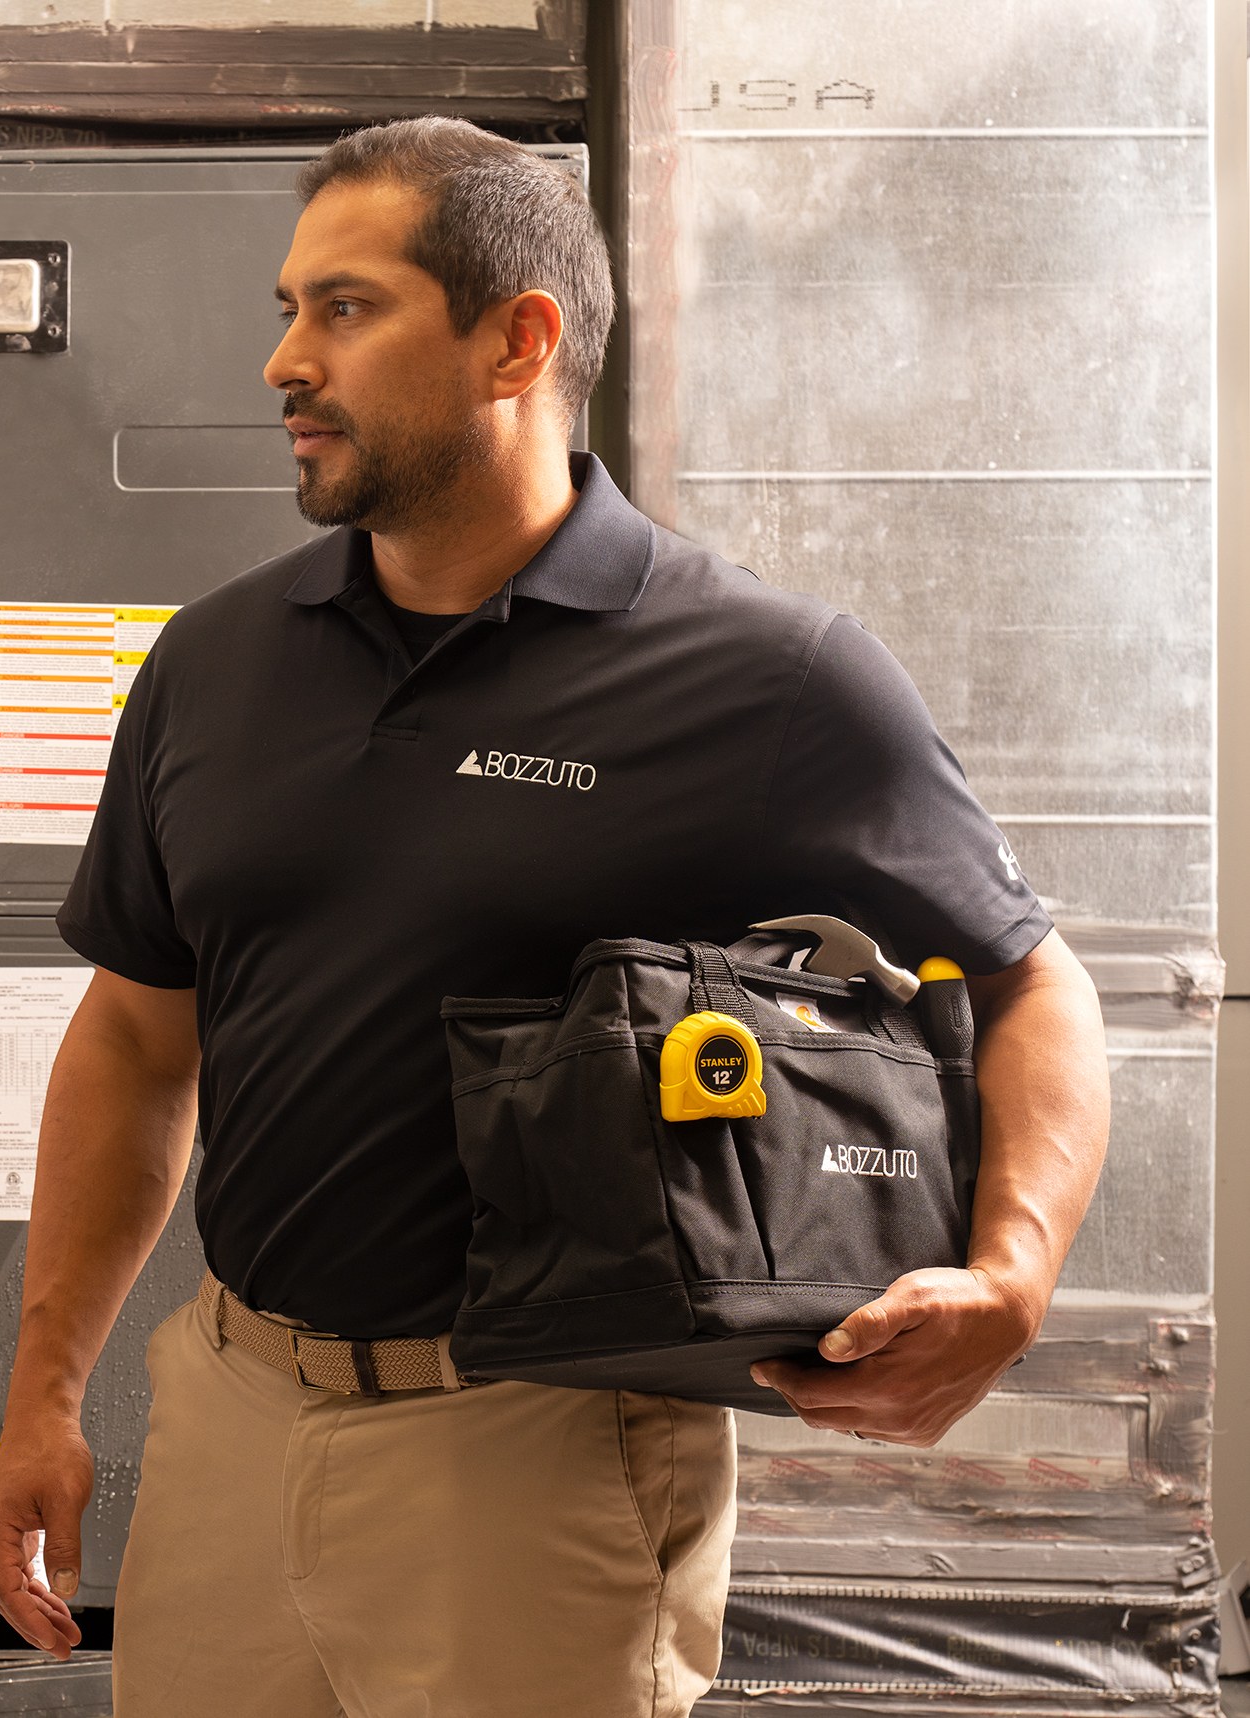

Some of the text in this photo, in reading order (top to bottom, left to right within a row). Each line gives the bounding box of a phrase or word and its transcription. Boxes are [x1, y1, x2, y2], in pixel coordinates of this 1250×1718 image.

[484, 750, 597, 791] BOZZUTO
[700, 1057, 742, 1067] STANLEY
[712, 1070, 733, 1085] 12'
[838, 1145, 918, 1179] BOZZUTO
